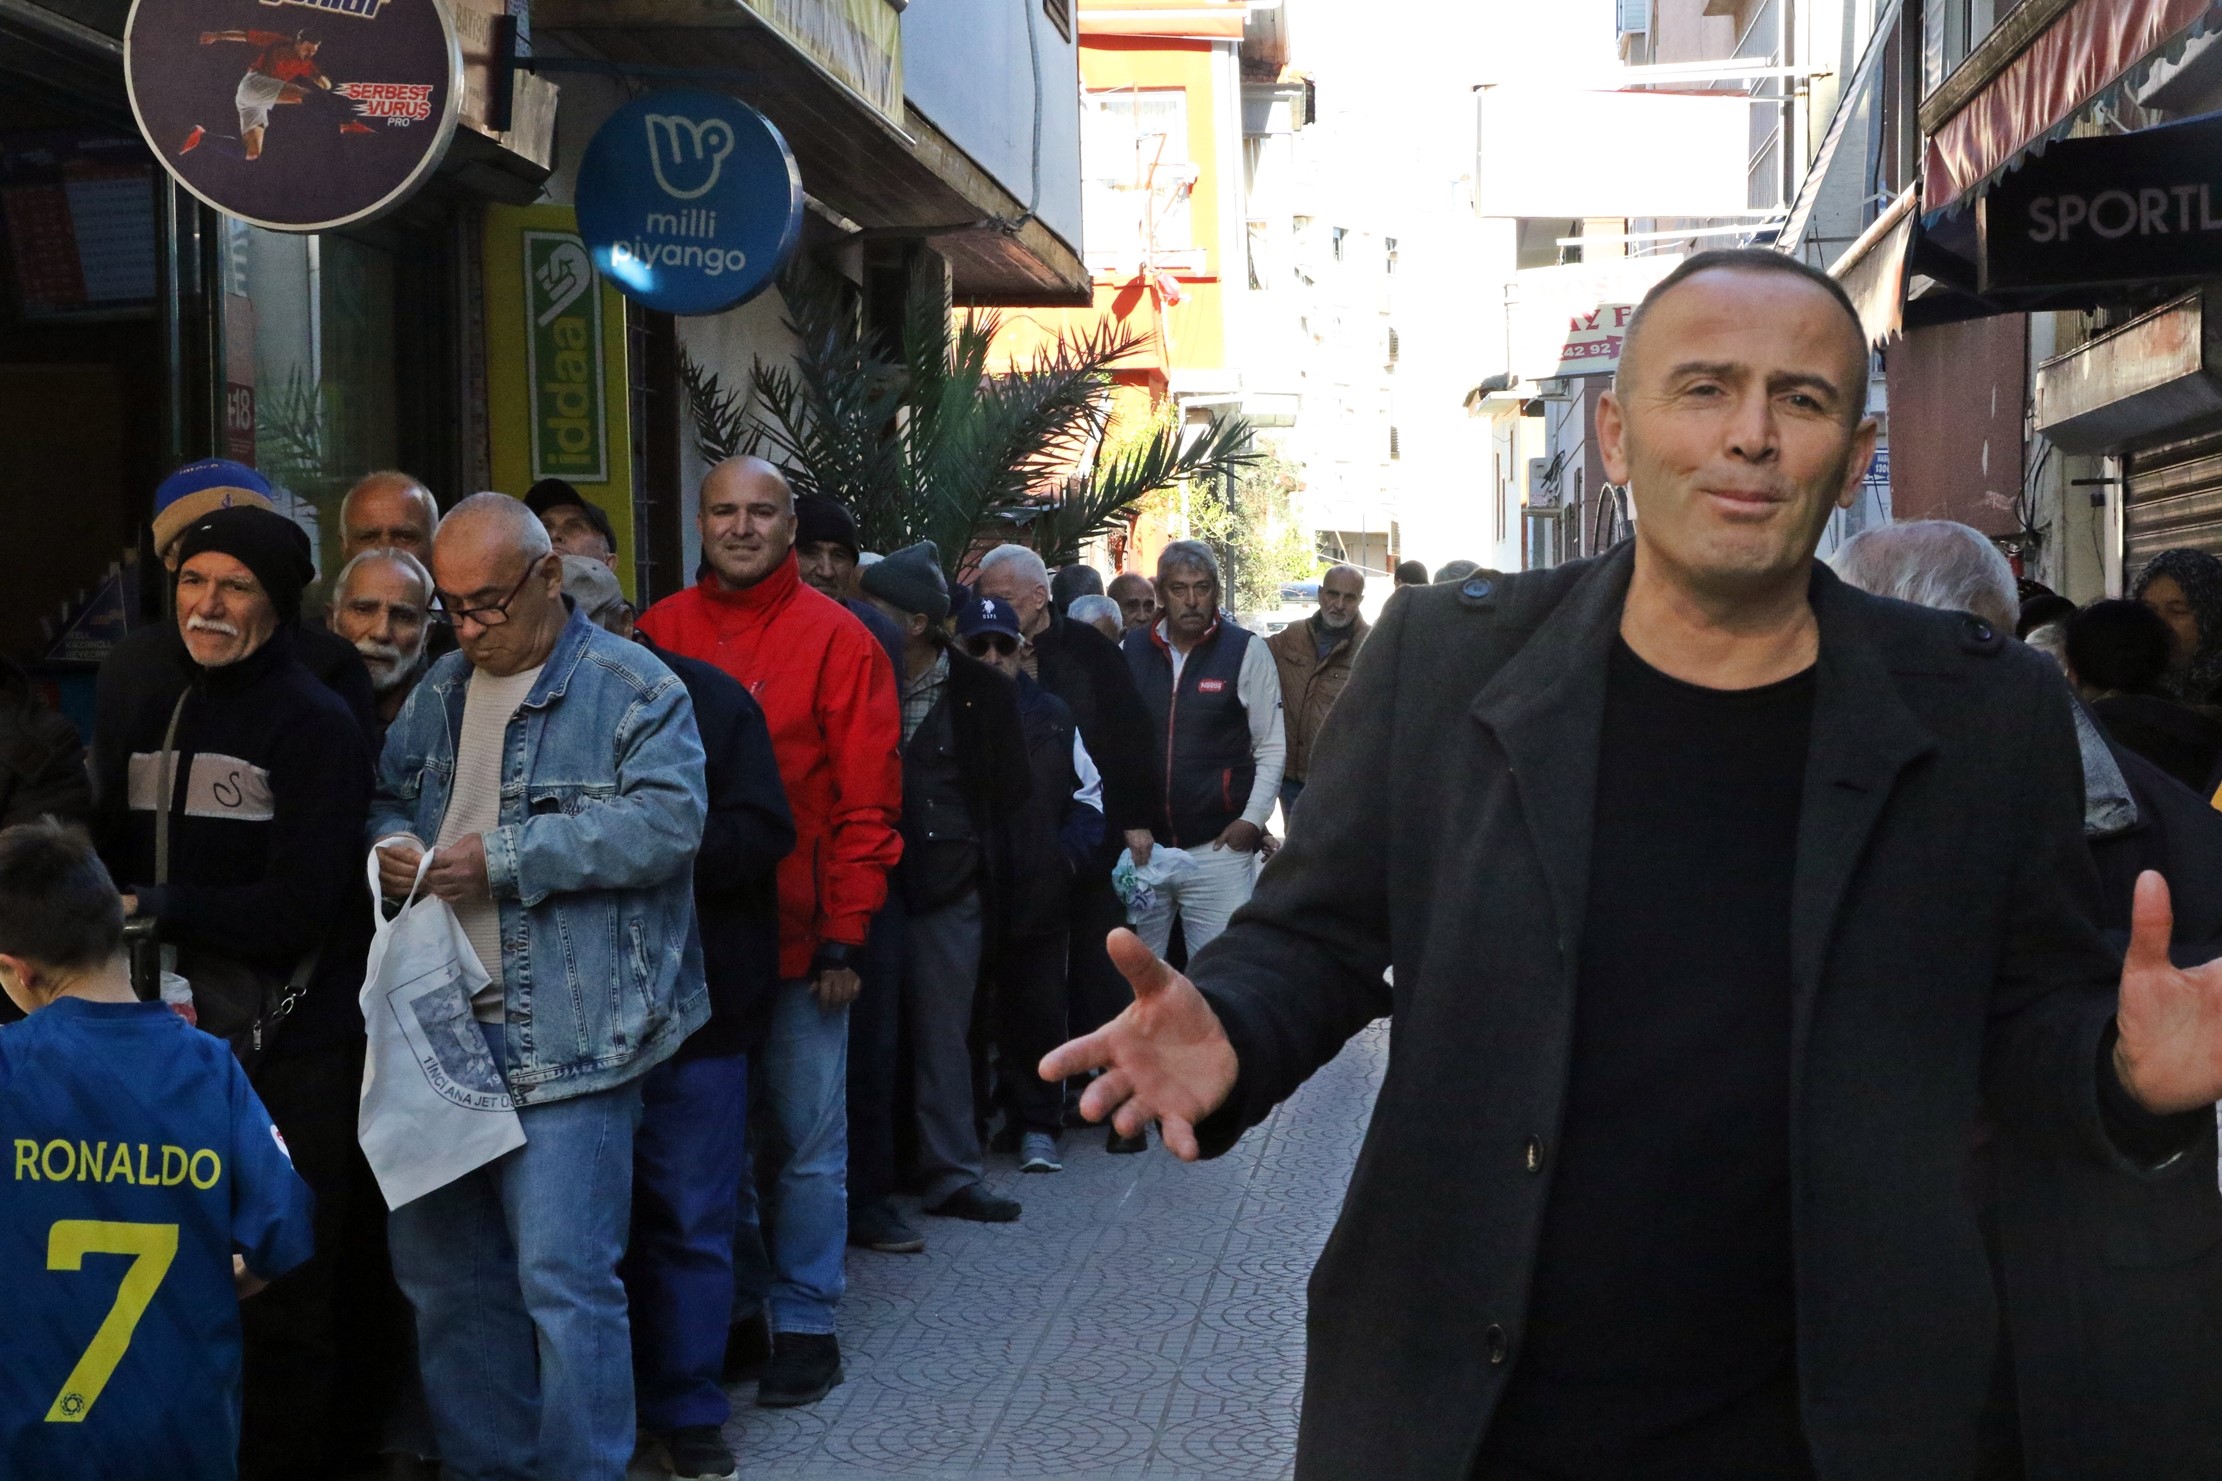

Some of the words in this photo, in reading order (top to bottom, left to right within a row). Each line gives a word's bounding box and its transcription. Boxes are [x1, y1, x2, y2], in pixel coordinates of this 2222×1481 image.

[347, 83, 433, 101] SERBEST
[367, 101, 432, 120] VURUŞ
[387, 117, 411, 127] PRO
[646, 208, 716, 239] milli
[610, 235, 746, 277] piyango
[1589, 343, 1611, 355] 92
[444, 1087, 472, 1106] ANA
[474, 1095, 498, 1108] JET
[13, 1138, 221, 1190] RONALDO
[43, 1219, 180, 1423] 7
